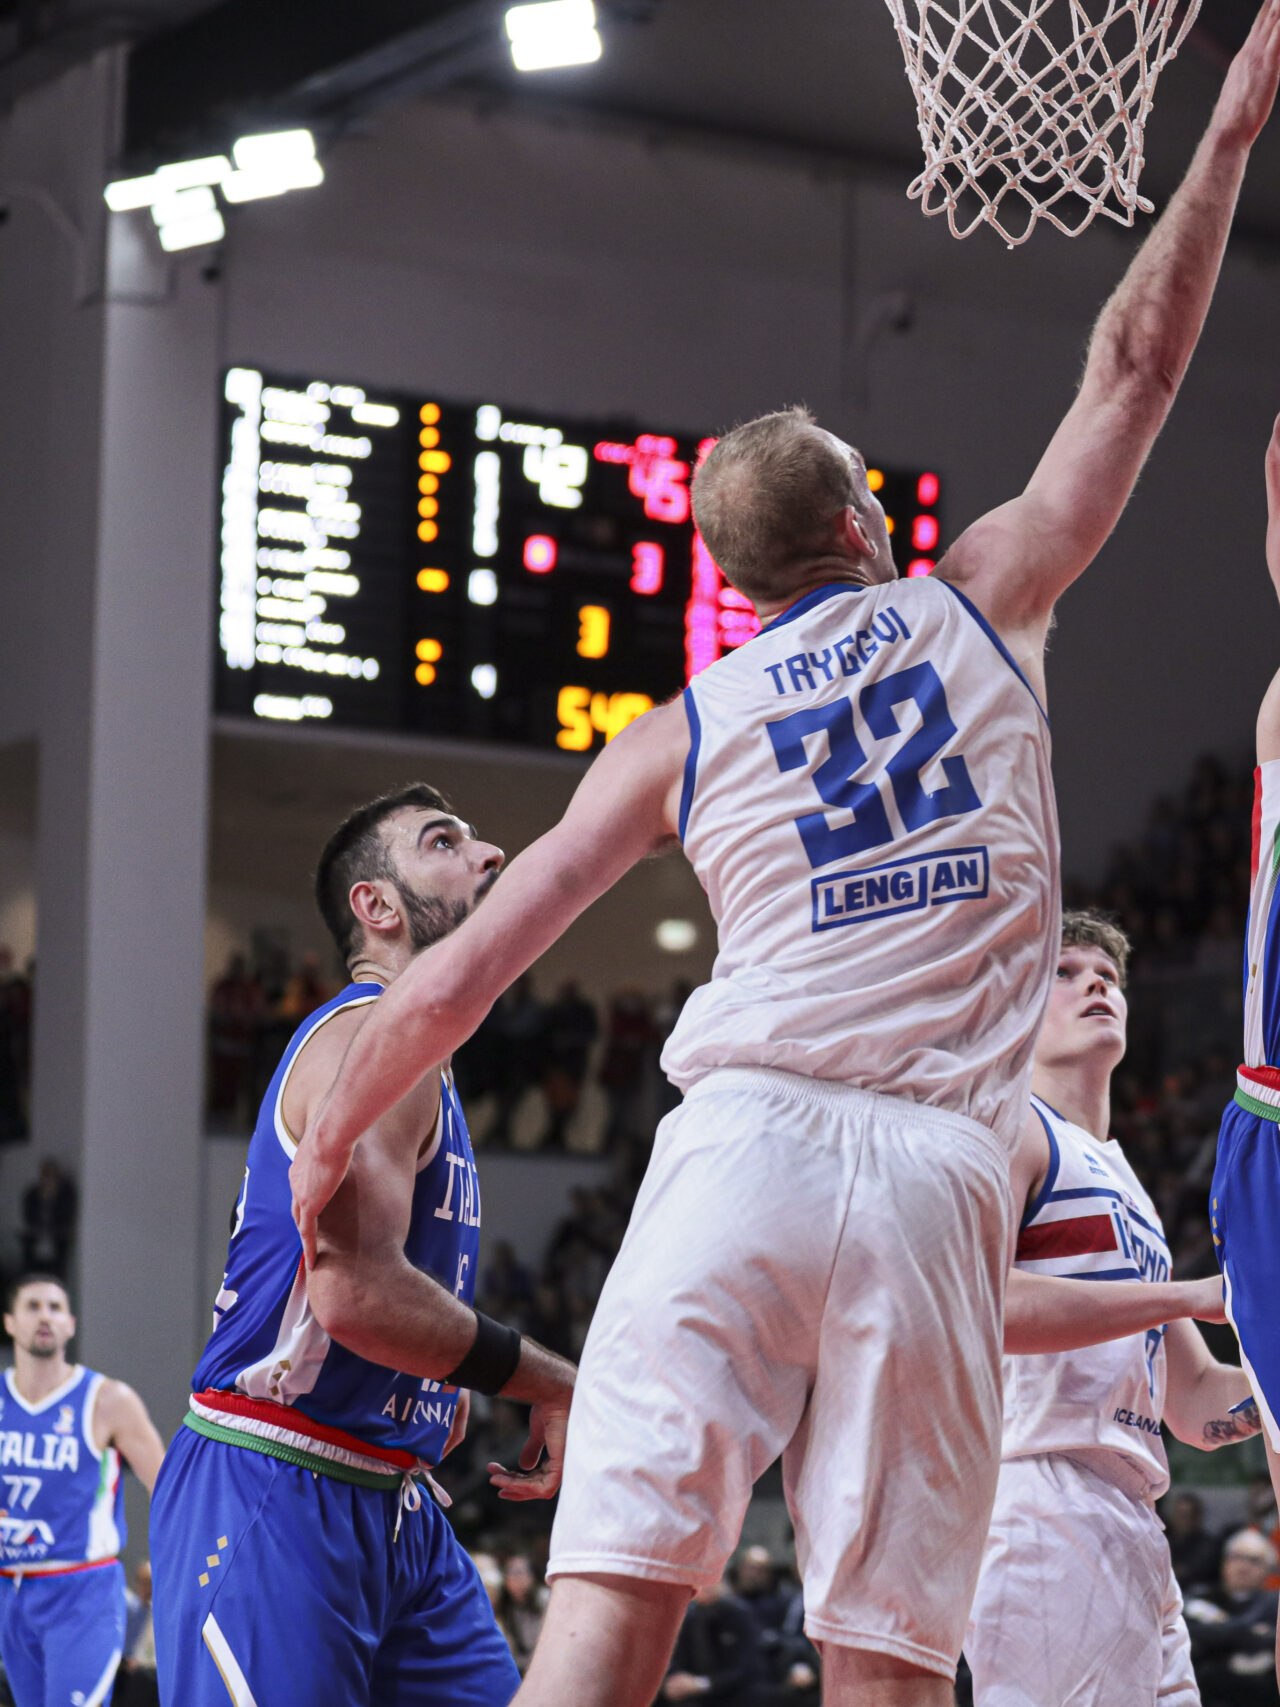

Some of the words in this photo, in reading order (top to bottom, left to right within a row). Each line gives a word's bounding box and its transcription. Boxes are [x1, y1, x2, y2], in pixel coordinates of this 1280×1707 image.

[764, 607, 911, 695] TRYGGVI
[766, 660, 982, 869] 32
[824, 858, 979, 916] LENGJAN
[2, 1474, 42, 1512] 77
